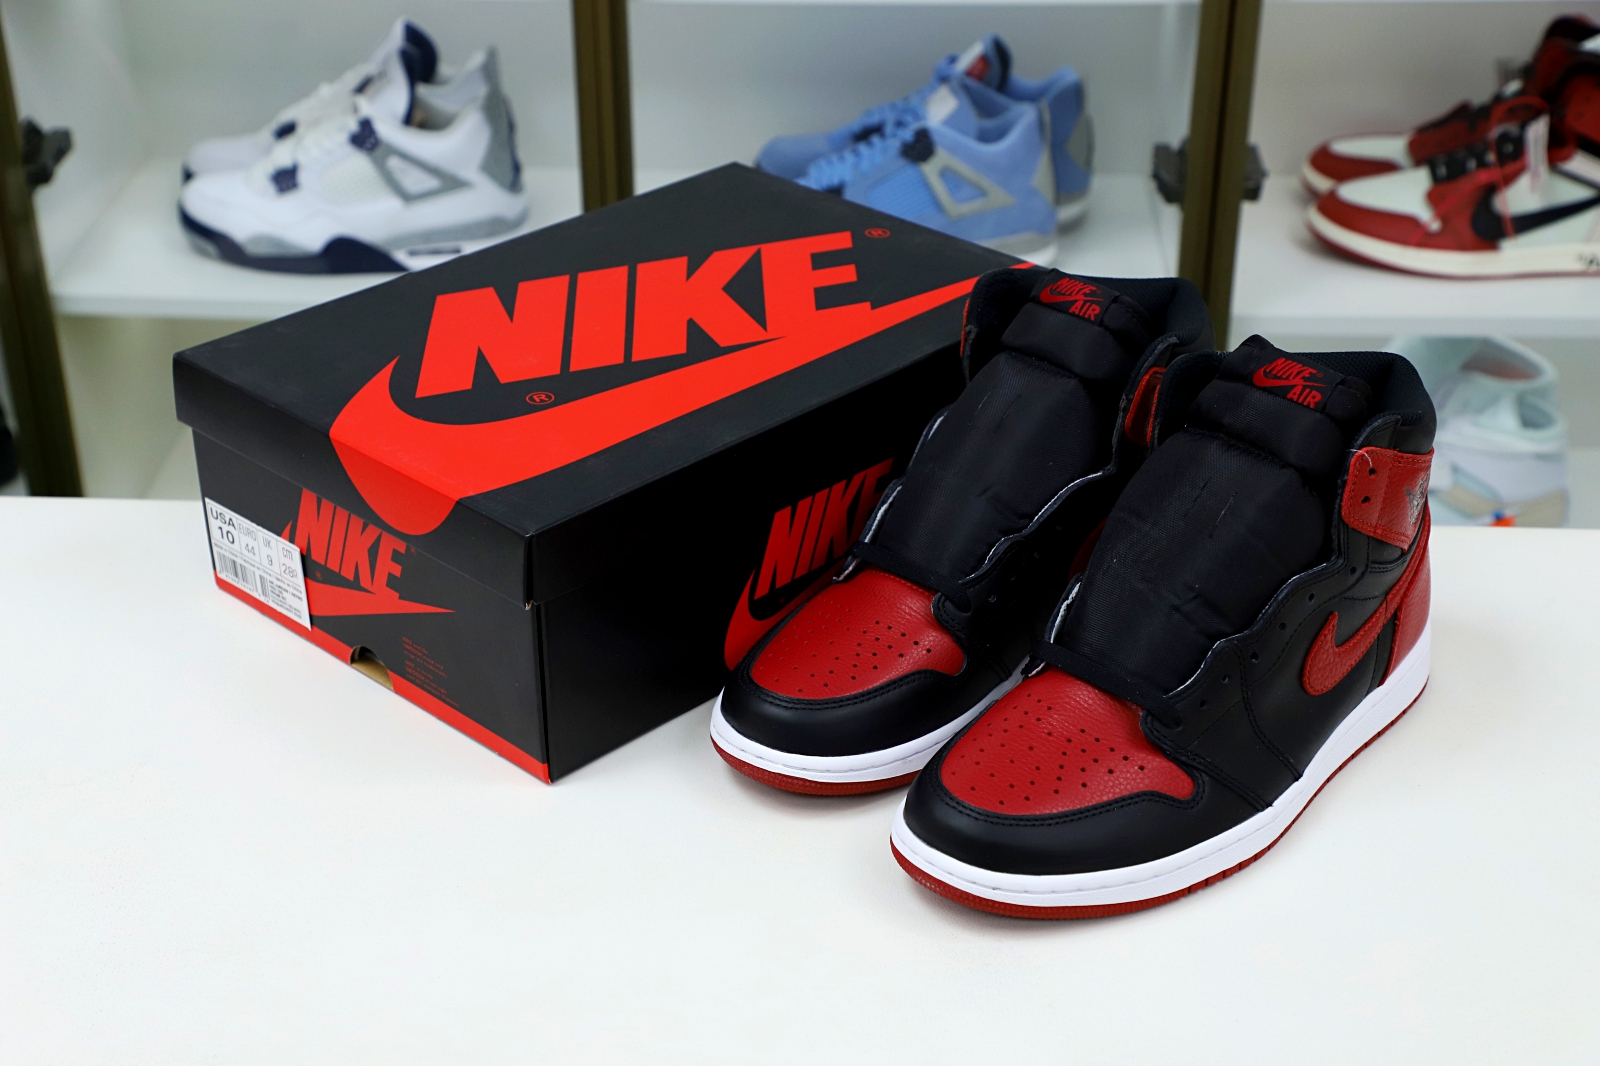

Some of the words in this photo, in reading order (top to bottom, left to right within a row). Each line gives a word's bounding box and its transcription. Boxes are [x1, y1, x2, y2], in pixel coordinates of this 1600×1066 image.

[1050, 277, 1098, 299] NIKE
[415, 231, 871, 398] NIKE
[1068, 299, 1101, 321] AIR
[1265, 357, 1318, 382] NIKE
[1286, 385, 1323, 409] AIR
[210, 507, 236, 531] USA
[238, 523, 257, 542] EURO
[262, 536, 273, 550] UK
[294, 488, 407, 600] NIKE
[217, 526, 235, 544] 10
[245, 543, 256, 556] 44
[267, 554, 273, 567] 9
